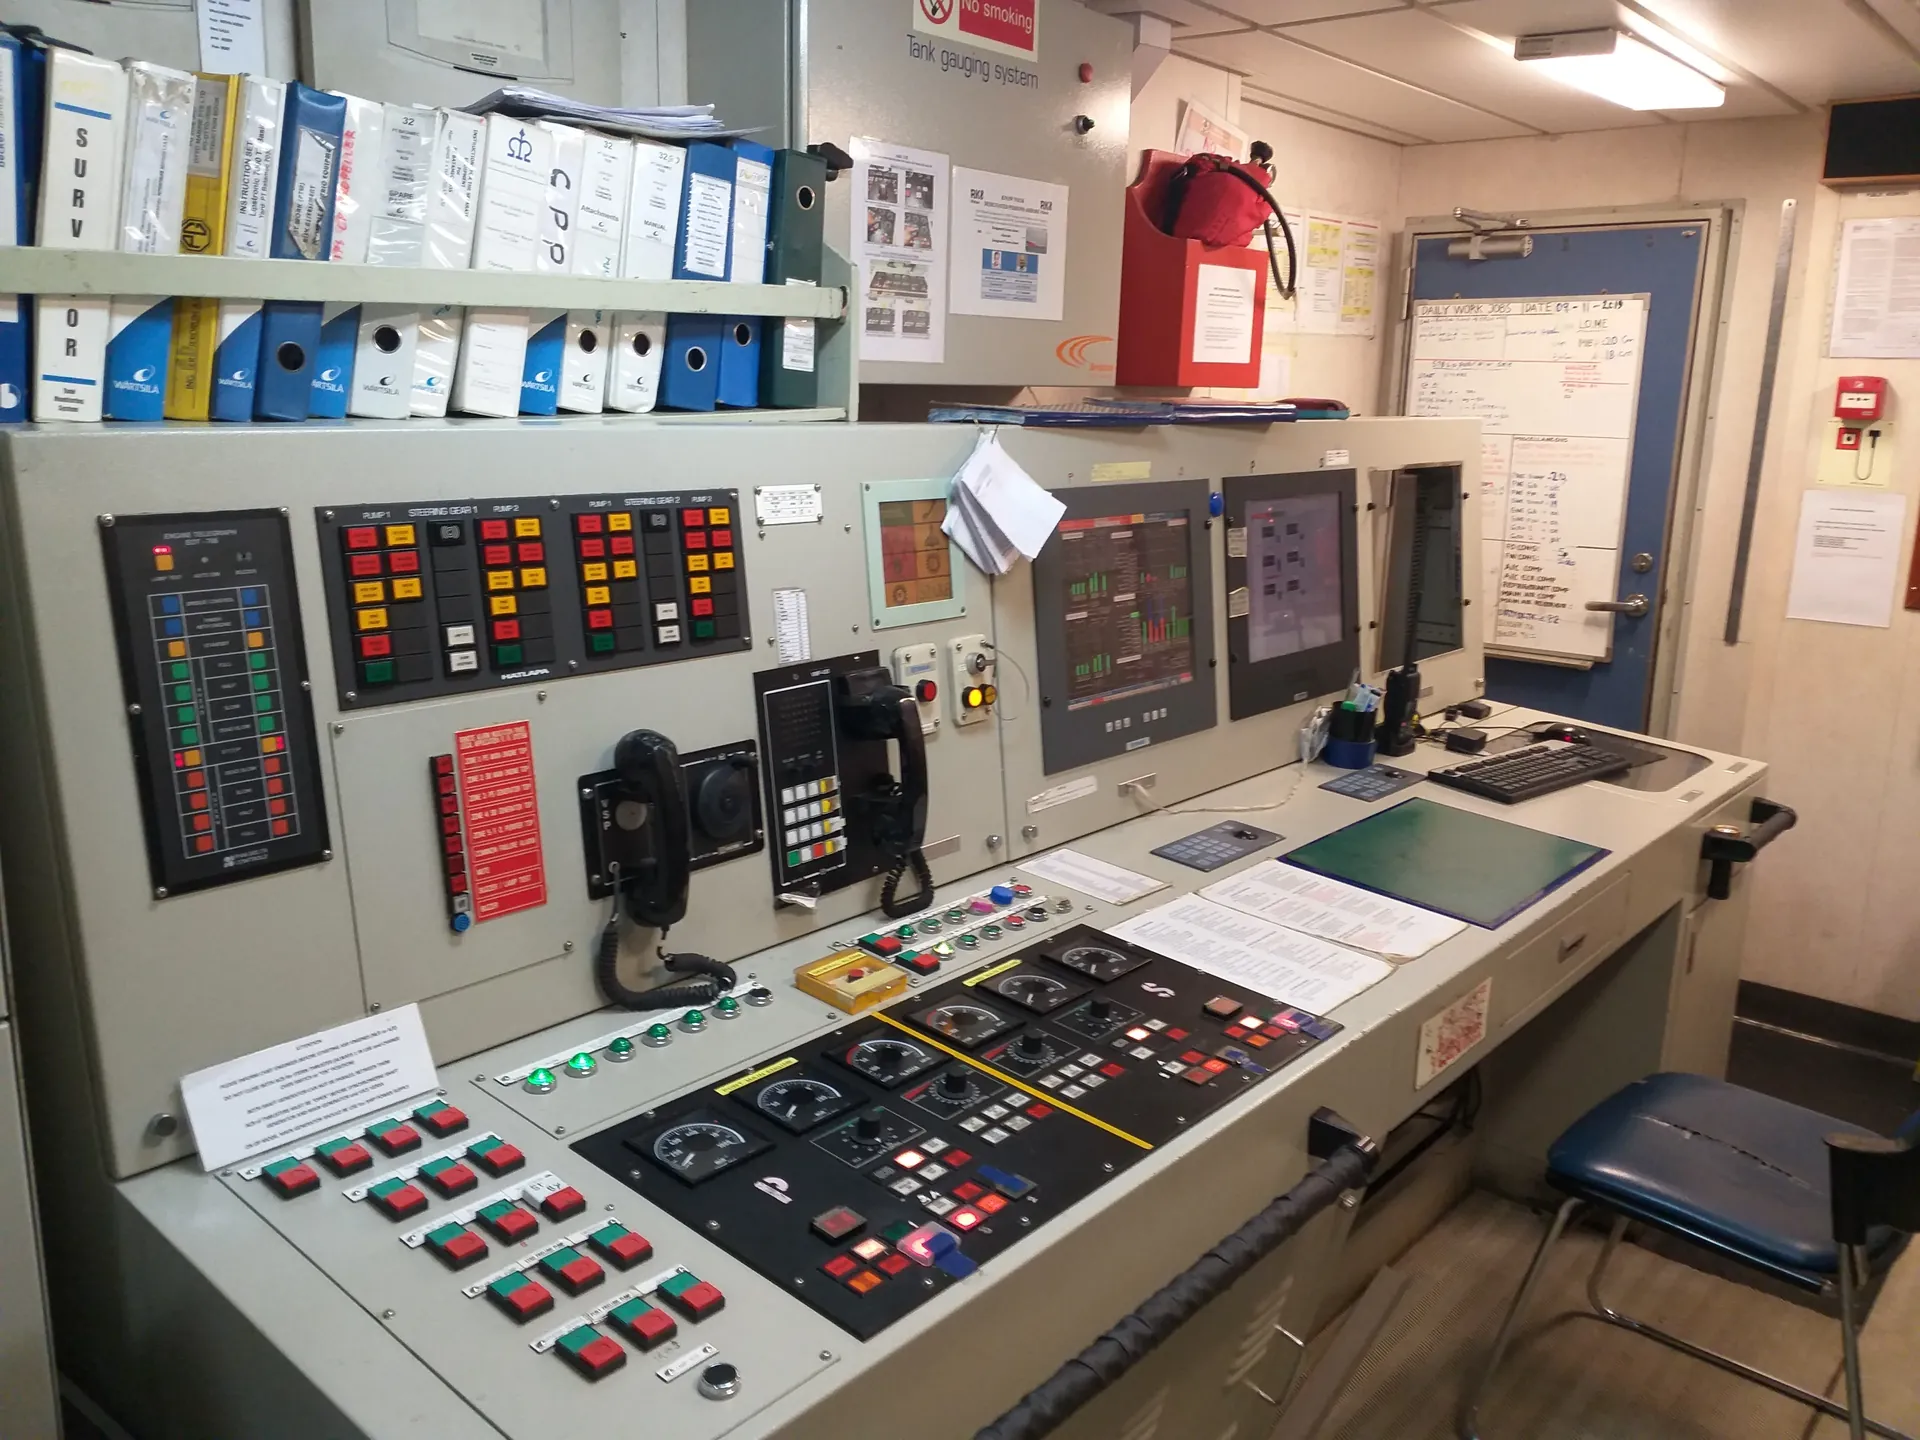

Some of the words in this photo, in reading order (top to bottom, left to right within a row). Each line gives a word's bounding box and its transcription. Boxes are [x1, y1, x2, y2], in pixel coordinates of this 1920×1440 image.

[983, 3, 1033, 34] smoking
[907, 34, 936, 62] Tank
[940, 50, 990, 82] gauging
[994, 64, 1039, 89] system
[402, 117, 415, 126] 32
[603, 141, 613, 150] 32
[240, 158, 252, 214] INSTRUCTION
[580, 205, 620, 223] Attachments
[1421, 305, 1450, 315] DAILY
[1454, 304, 1483, 314] WORK
[1488, 303, 1512, 313] JOBS
[1525, 302, 1552, 313] DATE
[589, 500, 607, 508] PUMP
[624, 497, 656, 507] STEERING
[657, 496, 674, 505] GEAR
[408, 508, 449, 517] STEERING
[450, 507, 471, 516] GEAR
[501, 668, 550, 680] HATLAPA
[1140, 982, 1176, 998] S
[744, 1070, 764, 1085] MAIN
[753, 1176, 793, 1204] P
